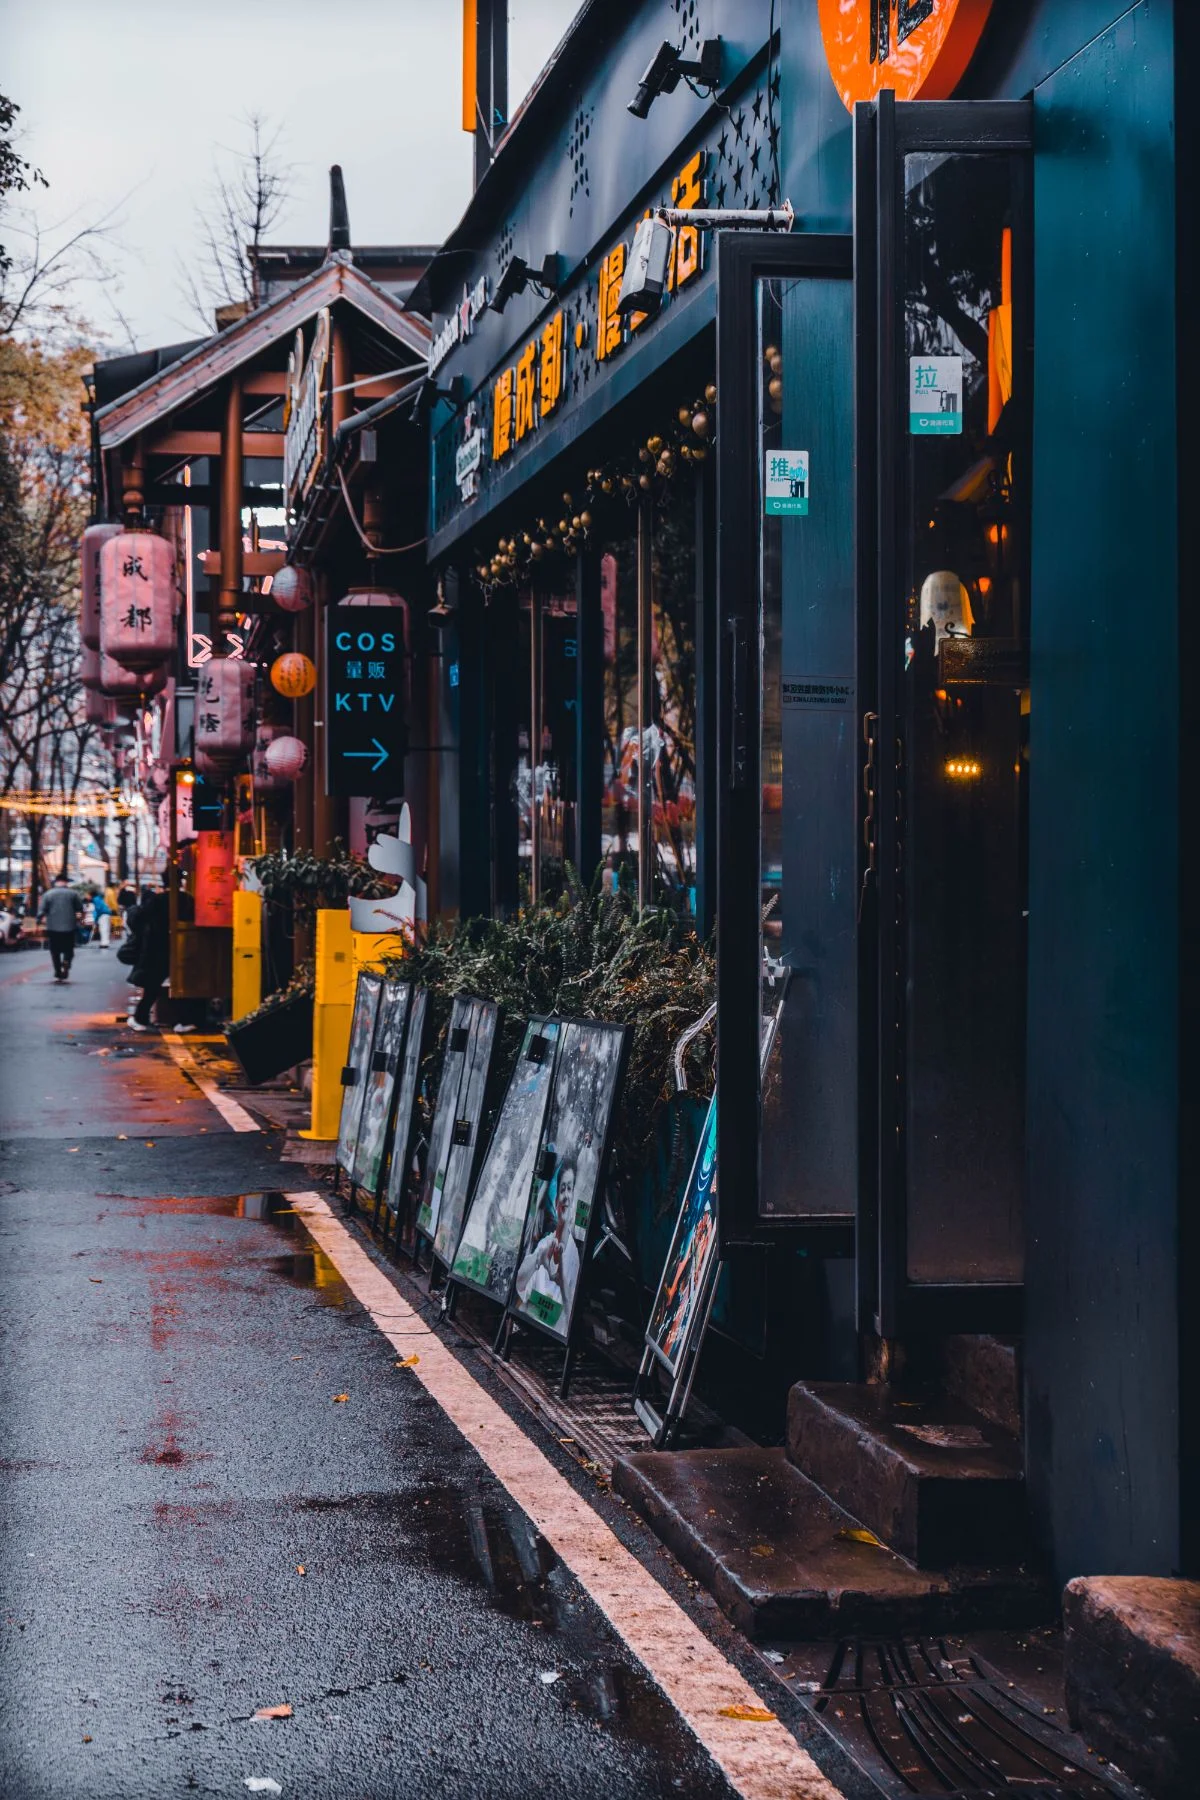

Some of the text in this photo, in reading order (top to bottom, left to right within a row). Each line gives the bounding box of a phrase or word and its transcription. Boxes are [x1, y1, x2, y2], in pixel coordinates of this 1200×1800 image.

[914, 364, 938, 389] 拉
[770, 457, 789, 477] 推
[120, 555, 153, 632] 成都
[335, 632, 396, 652] COS
[345, 660, 386, 679] 量贩
[335, 692, 396, 712] KTV
